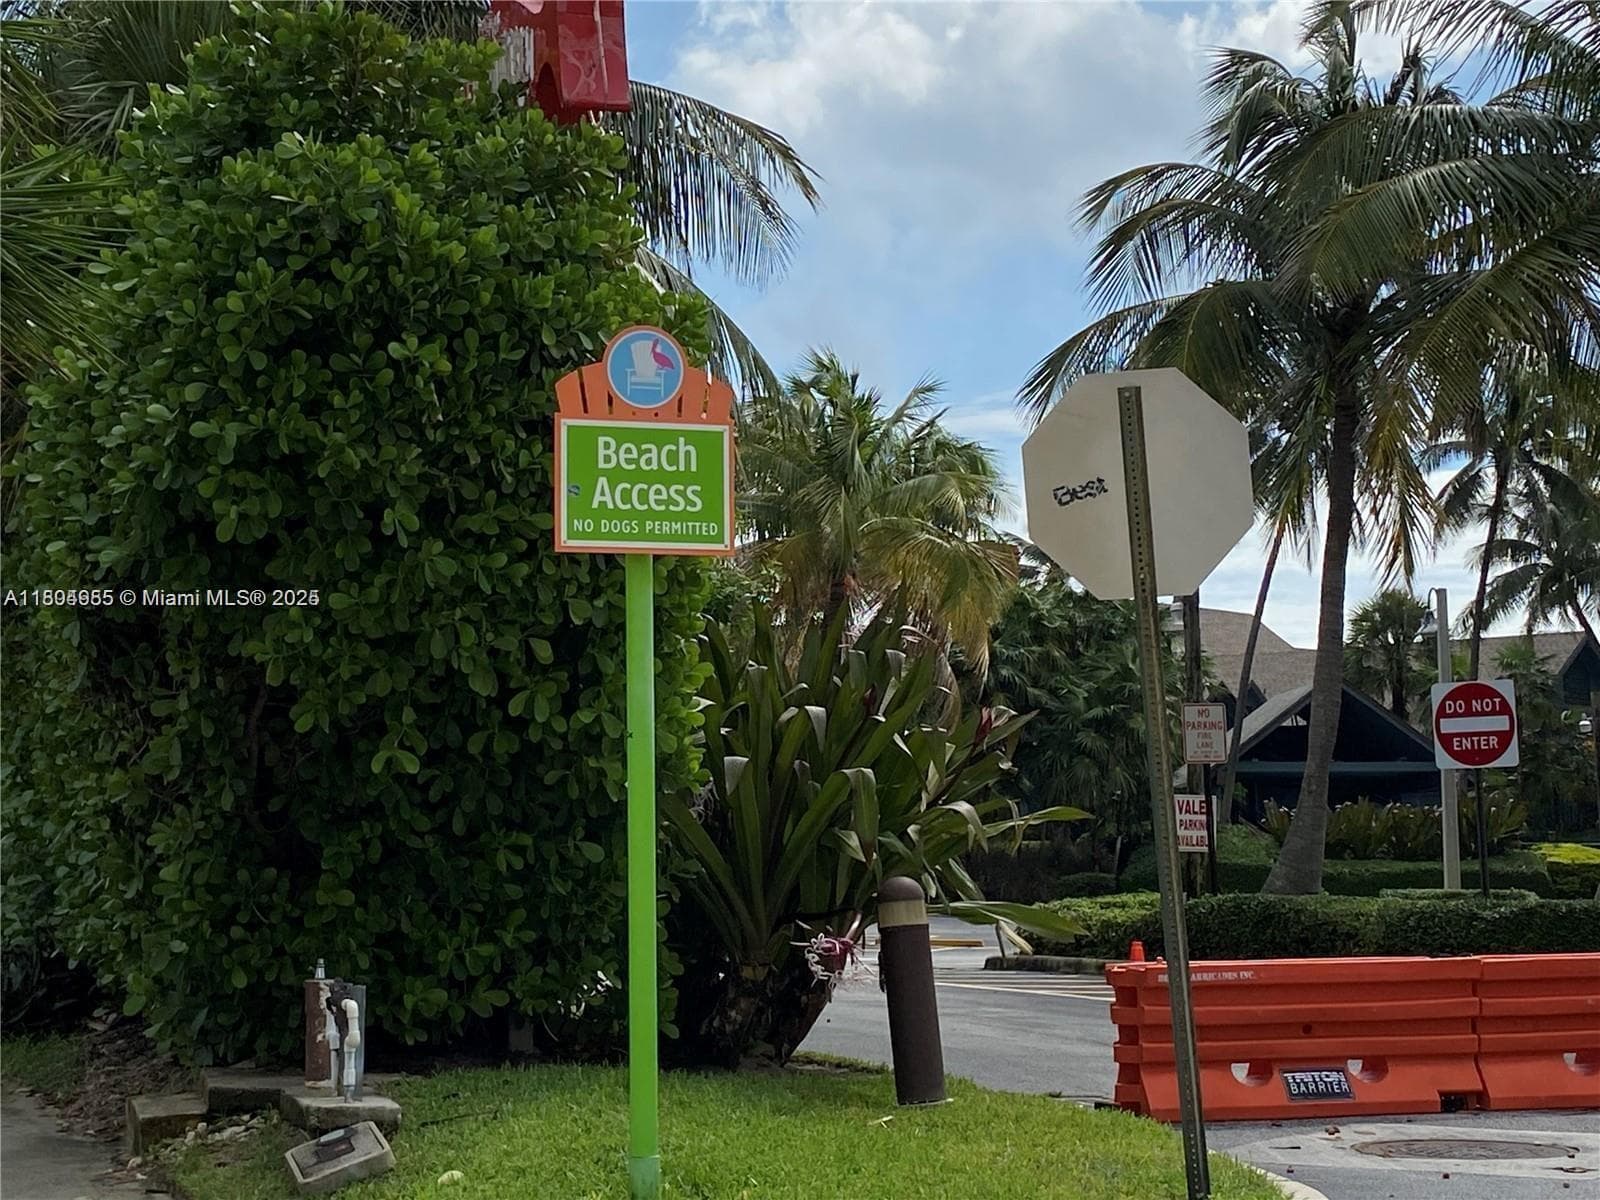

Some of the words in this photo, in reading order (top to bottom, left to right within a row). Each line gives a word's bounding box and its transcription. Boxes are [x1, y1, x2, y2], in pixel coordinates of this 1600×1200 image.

[597, 436, 697, 472] Beach
[591, 476, 703, 512] Access
[573, 519, 594, 532] NO
[601, 519, 639, 534] DOGS
[645, 520, 718, 536] PERMITTED
[1197, 708, 1210, 718] NO
[1445, 700, 1465, 714] DO
[1471, 698, 1501, 712] NOT
[1185, 721, 1223, 730] PARKING
[1453, 735, 1499, 750] ENTER
[1177, 799, 1206, 815] VALE
[1179, 819, 1206, 831] PARKIN
[1176, 835, 1209, 847] AVAILABL
[1190, 971, 1238, 982] ARRICADES
[1290, 1081, 1350, 1095] BARRIER
